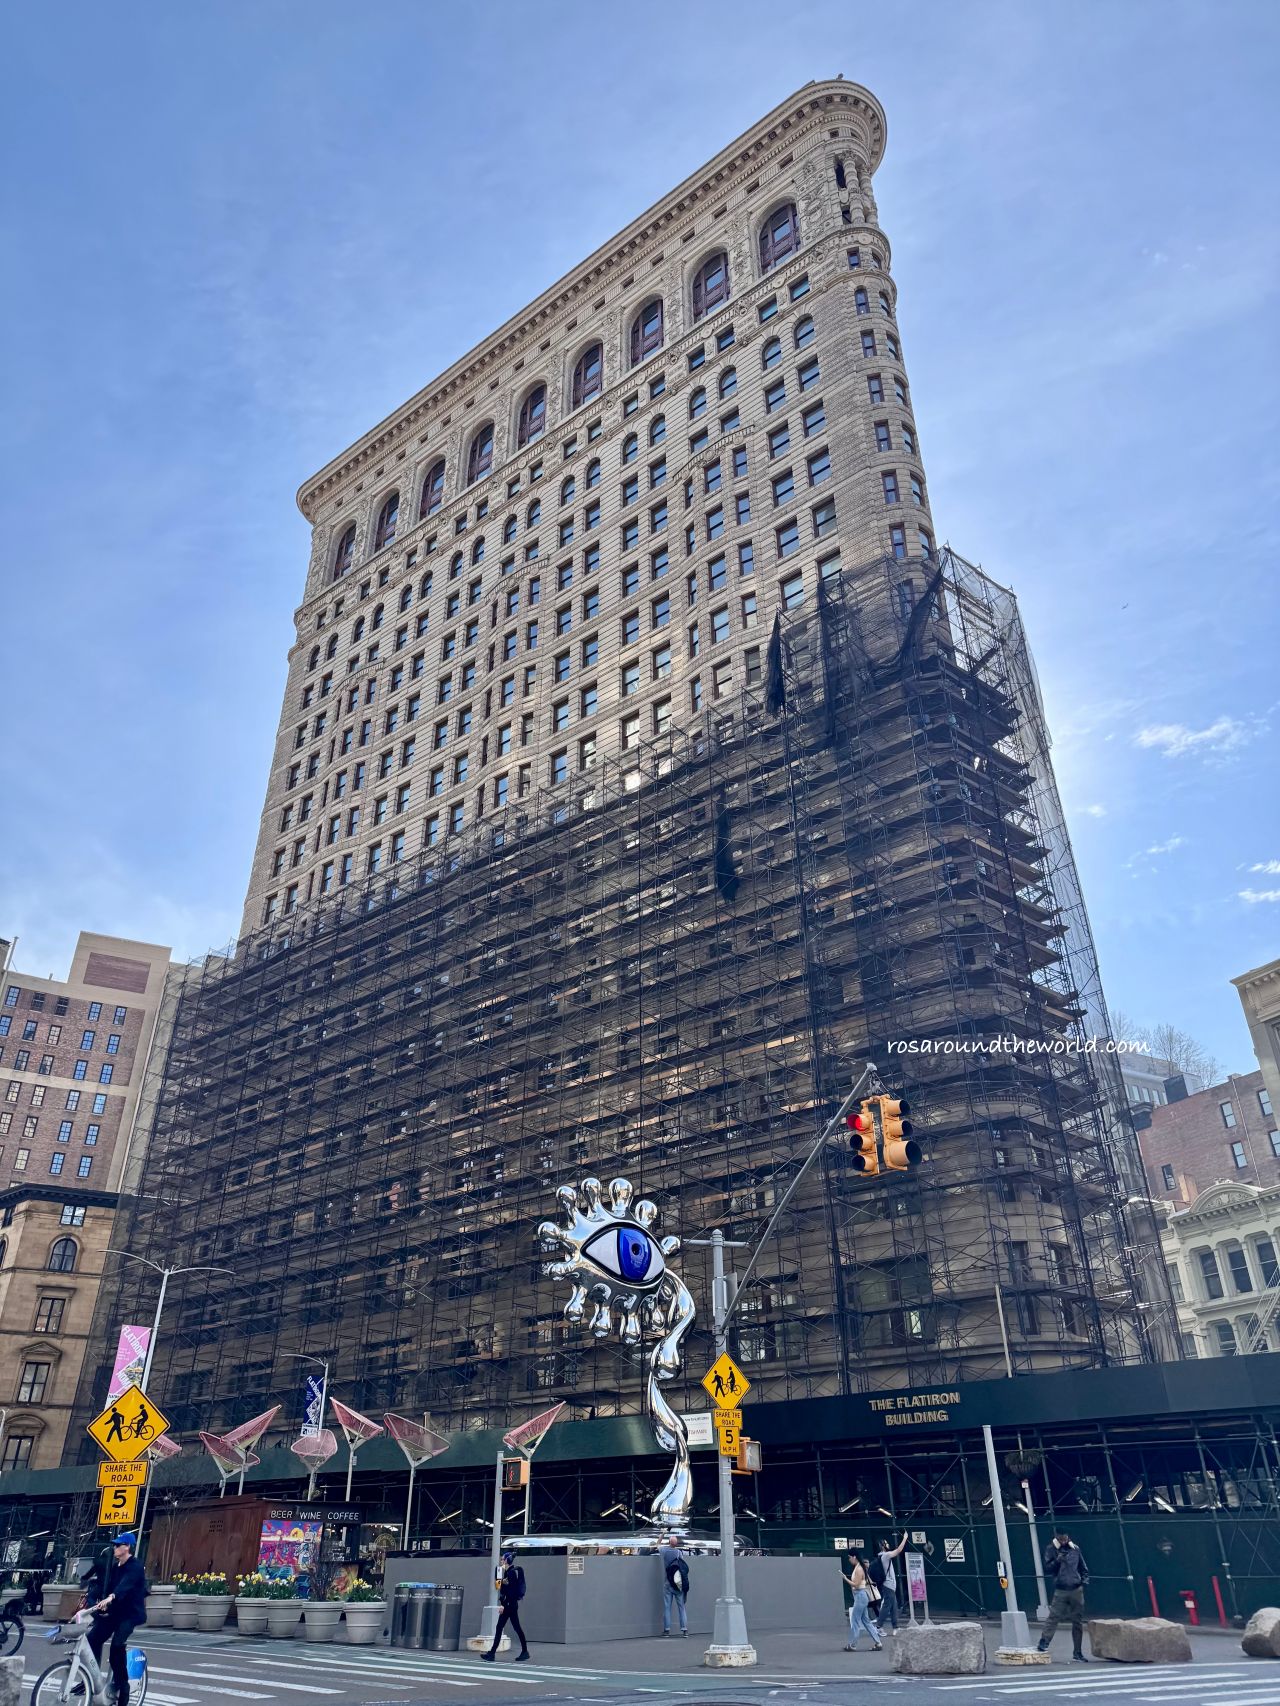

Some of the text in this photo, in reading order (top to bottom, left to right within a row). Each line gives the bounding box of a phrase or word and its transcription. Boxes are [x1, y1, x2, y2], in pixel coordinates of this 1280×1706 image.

[122, 1325, 146, 1357] FLATIRON
[869, 1391, 961, 1411] THE FLATIRON
[885, 1409, 949, 1426] BUILDING
[725, 1429, 734, 1444] 5
[104, 1463, 143, 1473] SHARE THE
[111, 1474, 134, 1482] ROAD
[112, 1489, 127, 1508] 5
[270, 1510, 360, 1521] BEER WINE COFFEE
